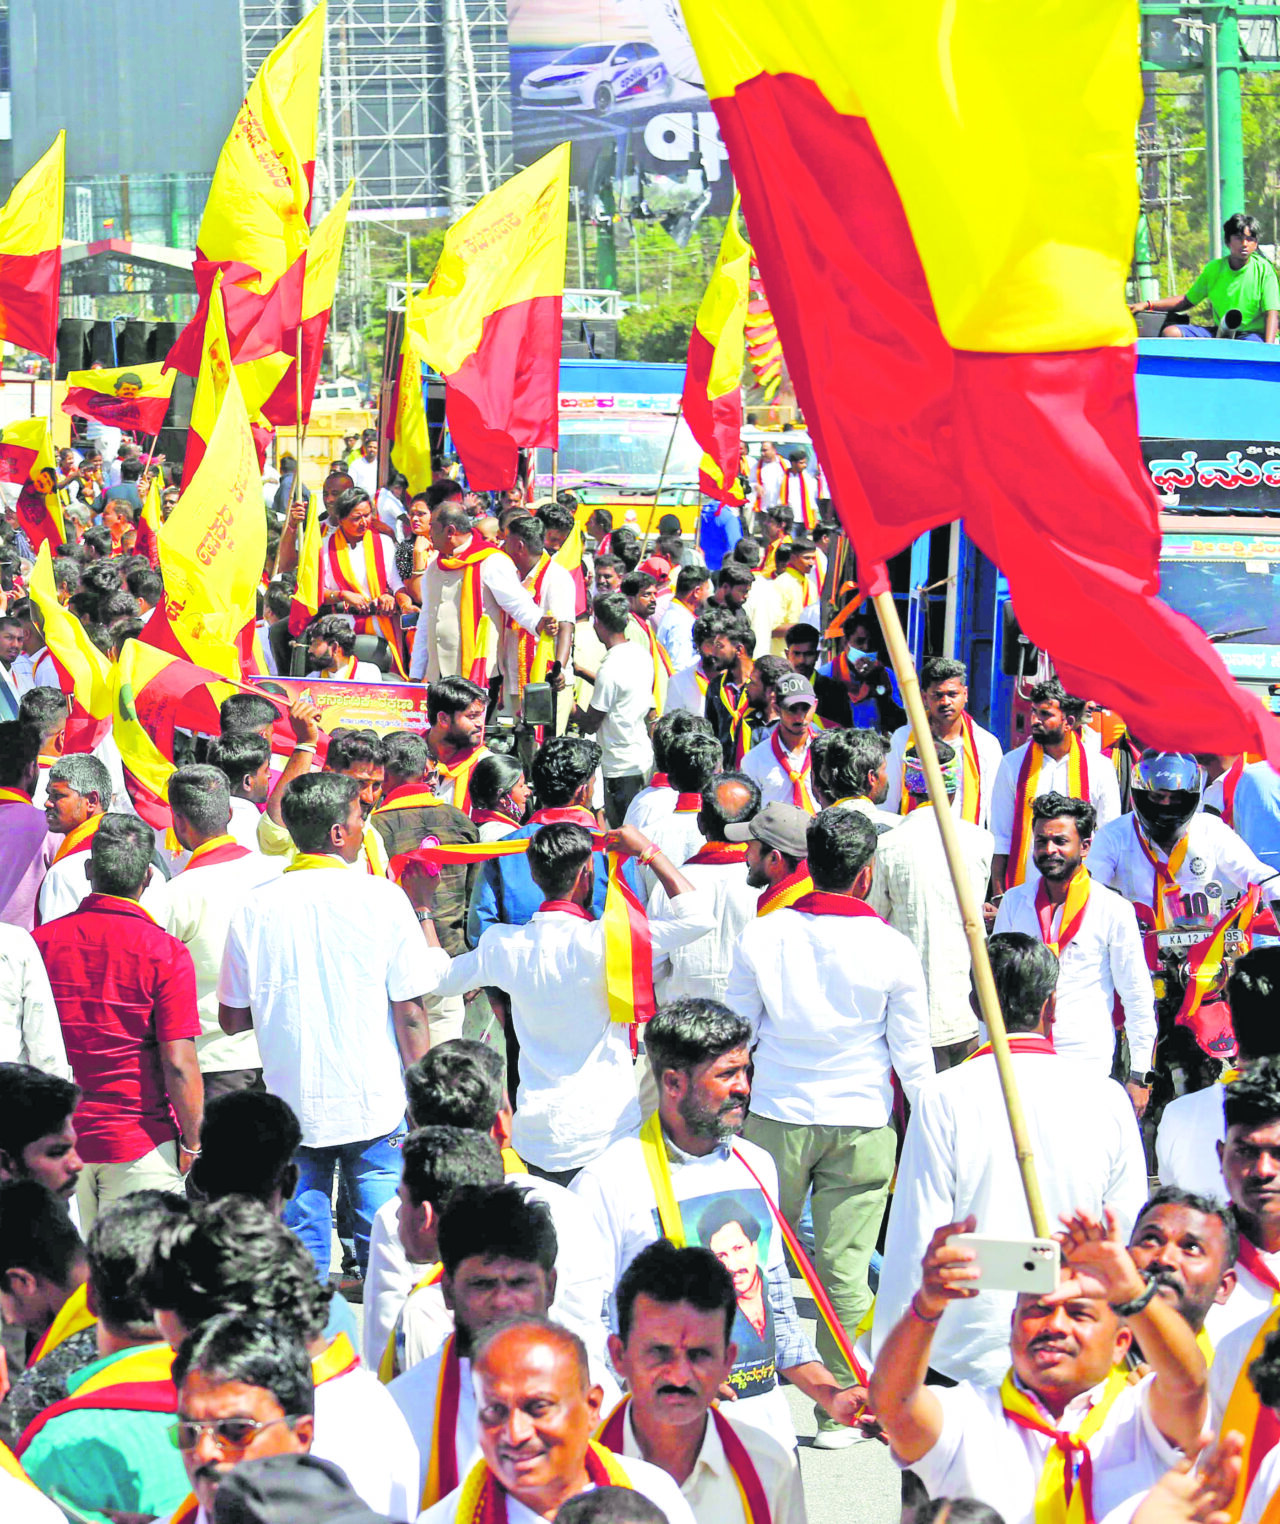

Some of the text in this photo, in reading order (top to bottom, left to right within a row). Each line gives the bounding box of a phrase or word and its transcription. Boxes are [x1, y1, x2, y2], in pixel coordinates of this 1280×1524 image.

[782, 680, 804, 694] BOY
[1179, 892, 1209, 918] 10
[1170, 936, 1182, 945] KA
[1188, 934, 1199, 943] 12
